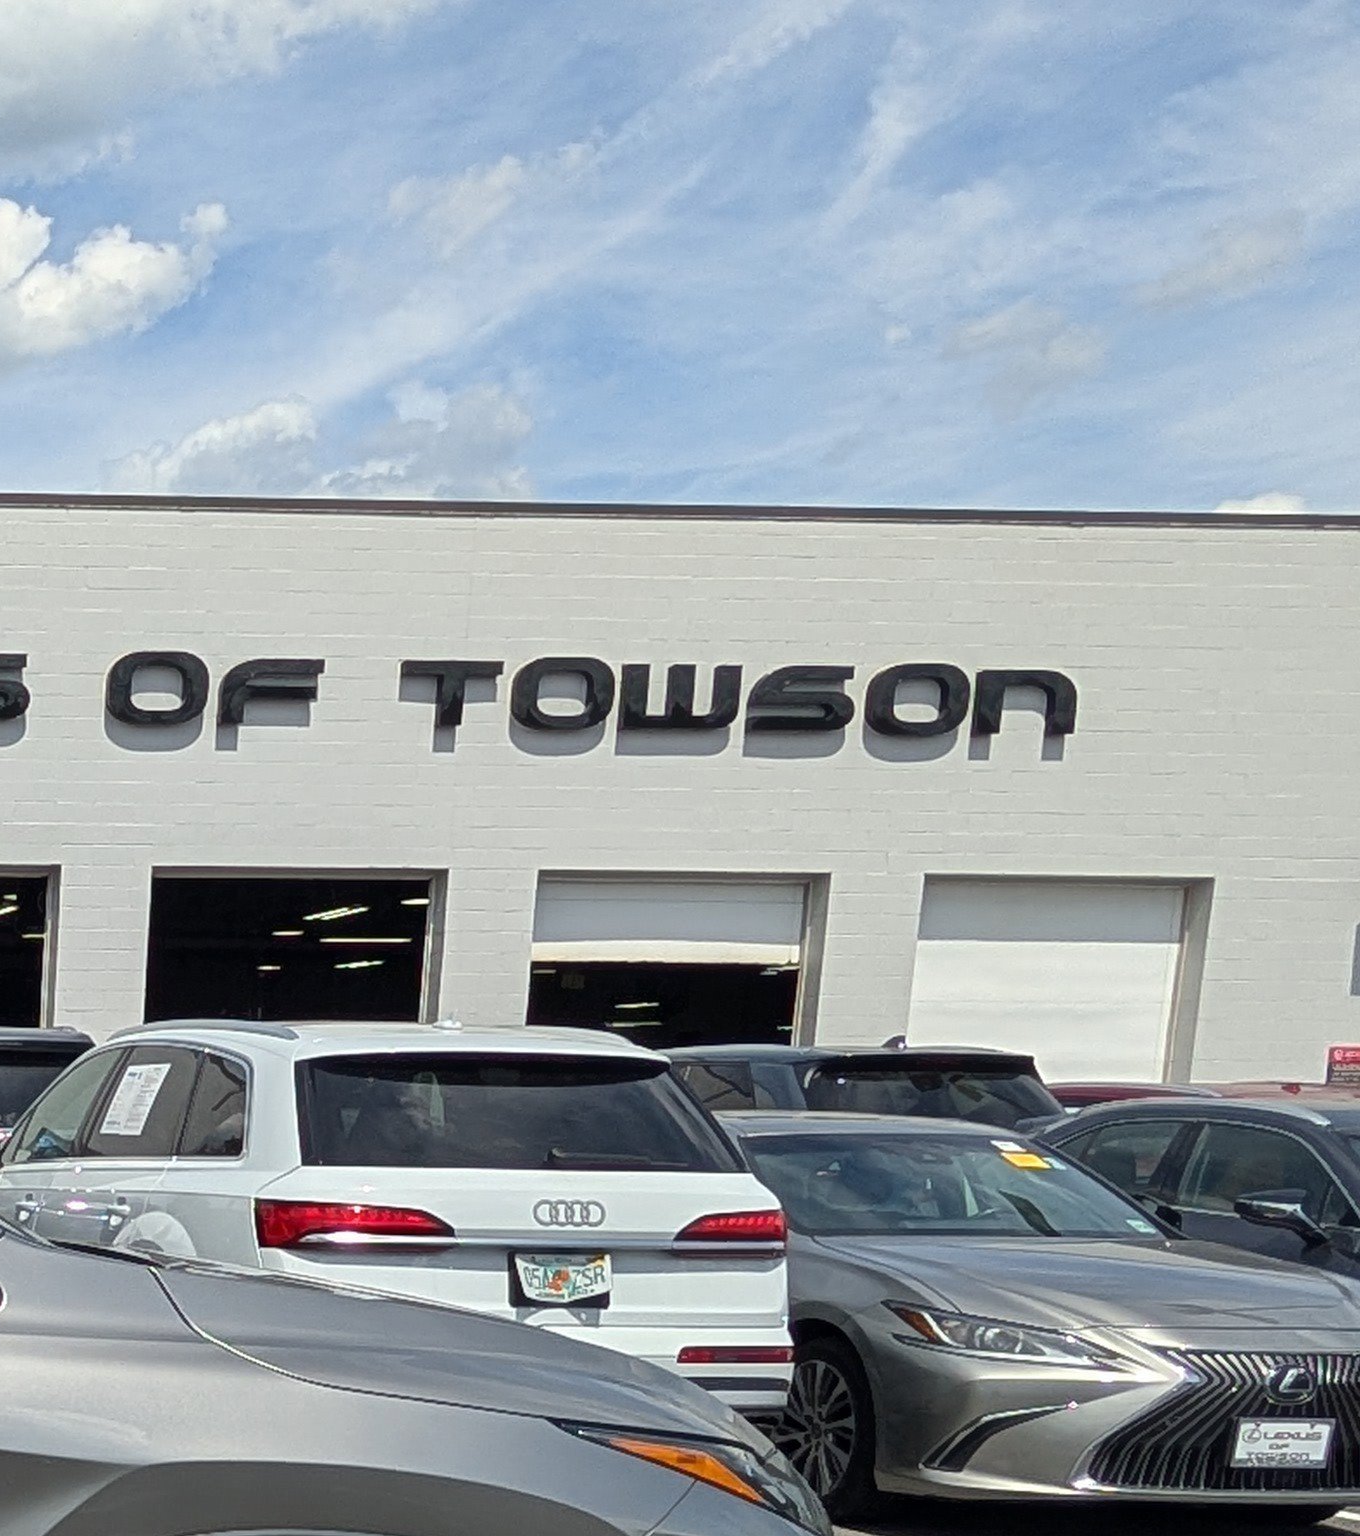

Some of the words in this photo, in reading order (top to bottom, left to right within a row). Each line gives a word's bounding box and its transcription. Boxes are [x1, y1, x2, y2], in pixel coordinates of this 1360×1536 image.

[106, 649, 325, 727] OF
[399, 656, 1079, 737] TOWSON
[1263, 1431, 1322, 1441] LEXUS
